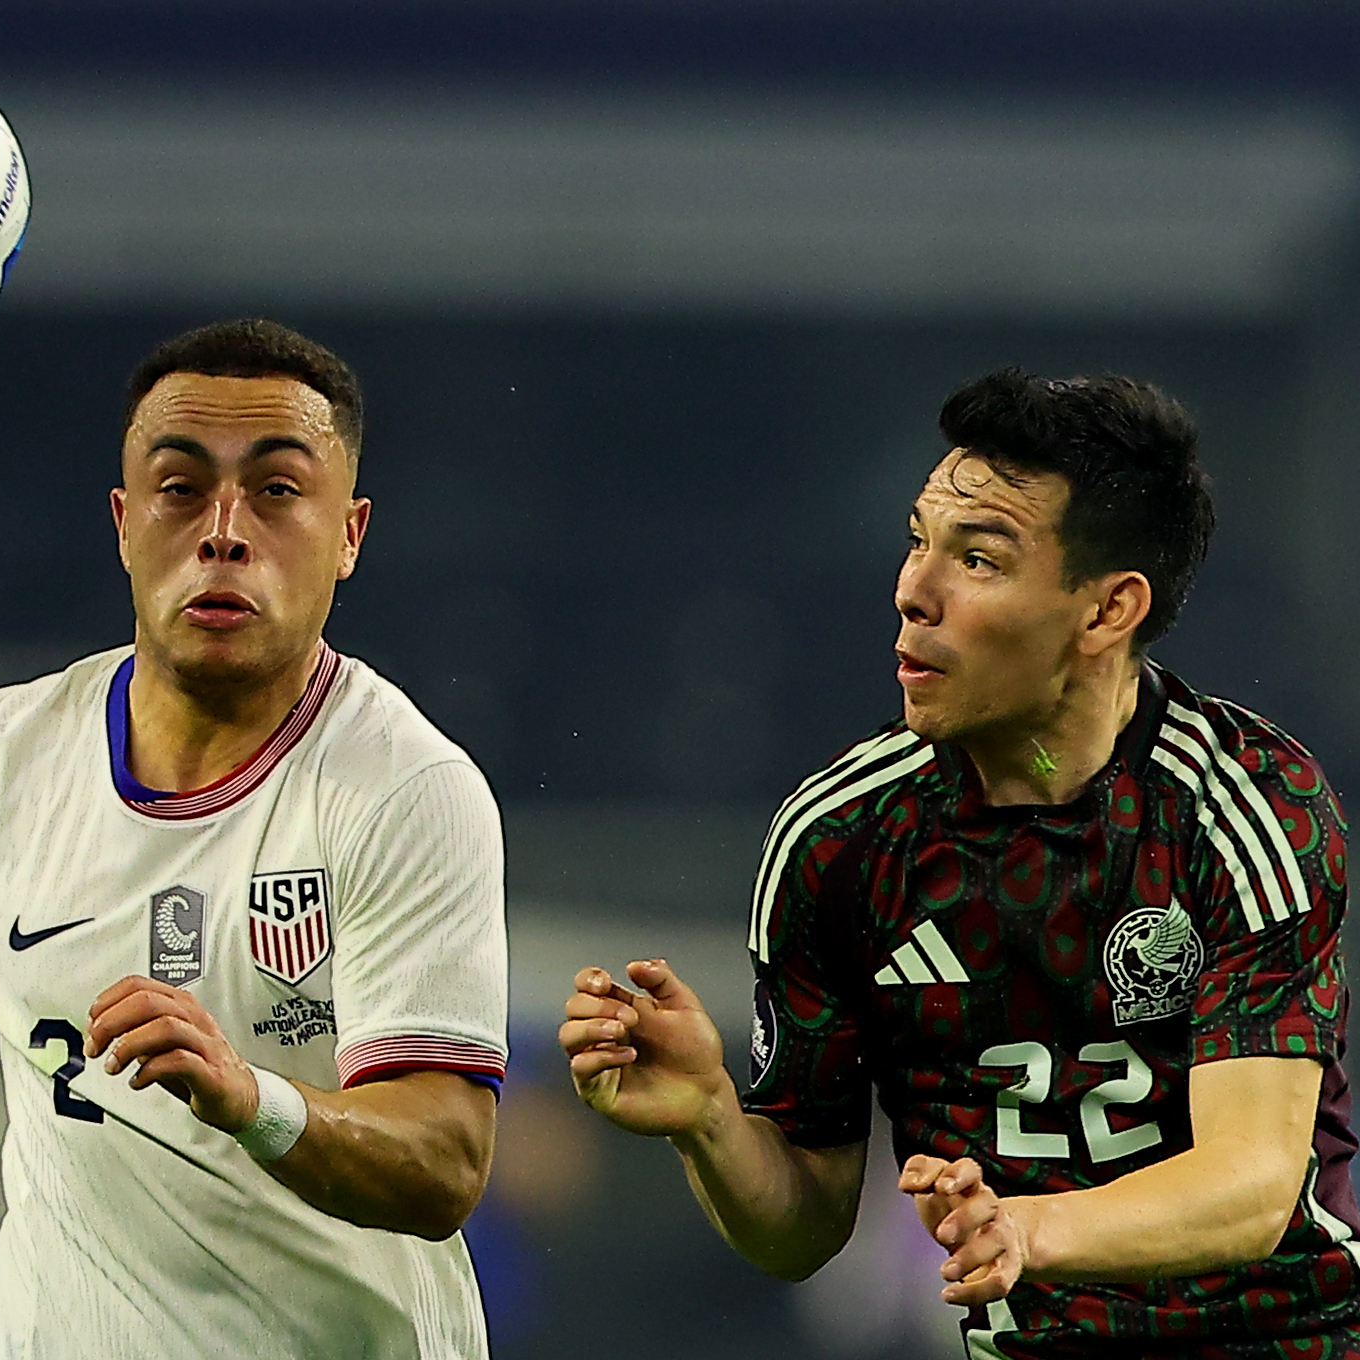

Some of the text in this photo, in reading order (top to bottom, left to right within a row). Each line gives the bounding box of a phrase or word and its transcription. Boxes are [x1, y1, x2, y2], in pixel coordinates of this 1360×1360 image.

[249, 877, 320, 922] USA
[153, 961, 200, 971] CHAMPIONS
[271, 1003, 288, 1018] US
[286, 997, 303, 1010] VS
[280, 1034, 295, 1046] 24
[296, 1022, 329, 1046] MARCH
[28, 1018, 104, 1125] 2
[978, 1040, 1162, 1163] 22
